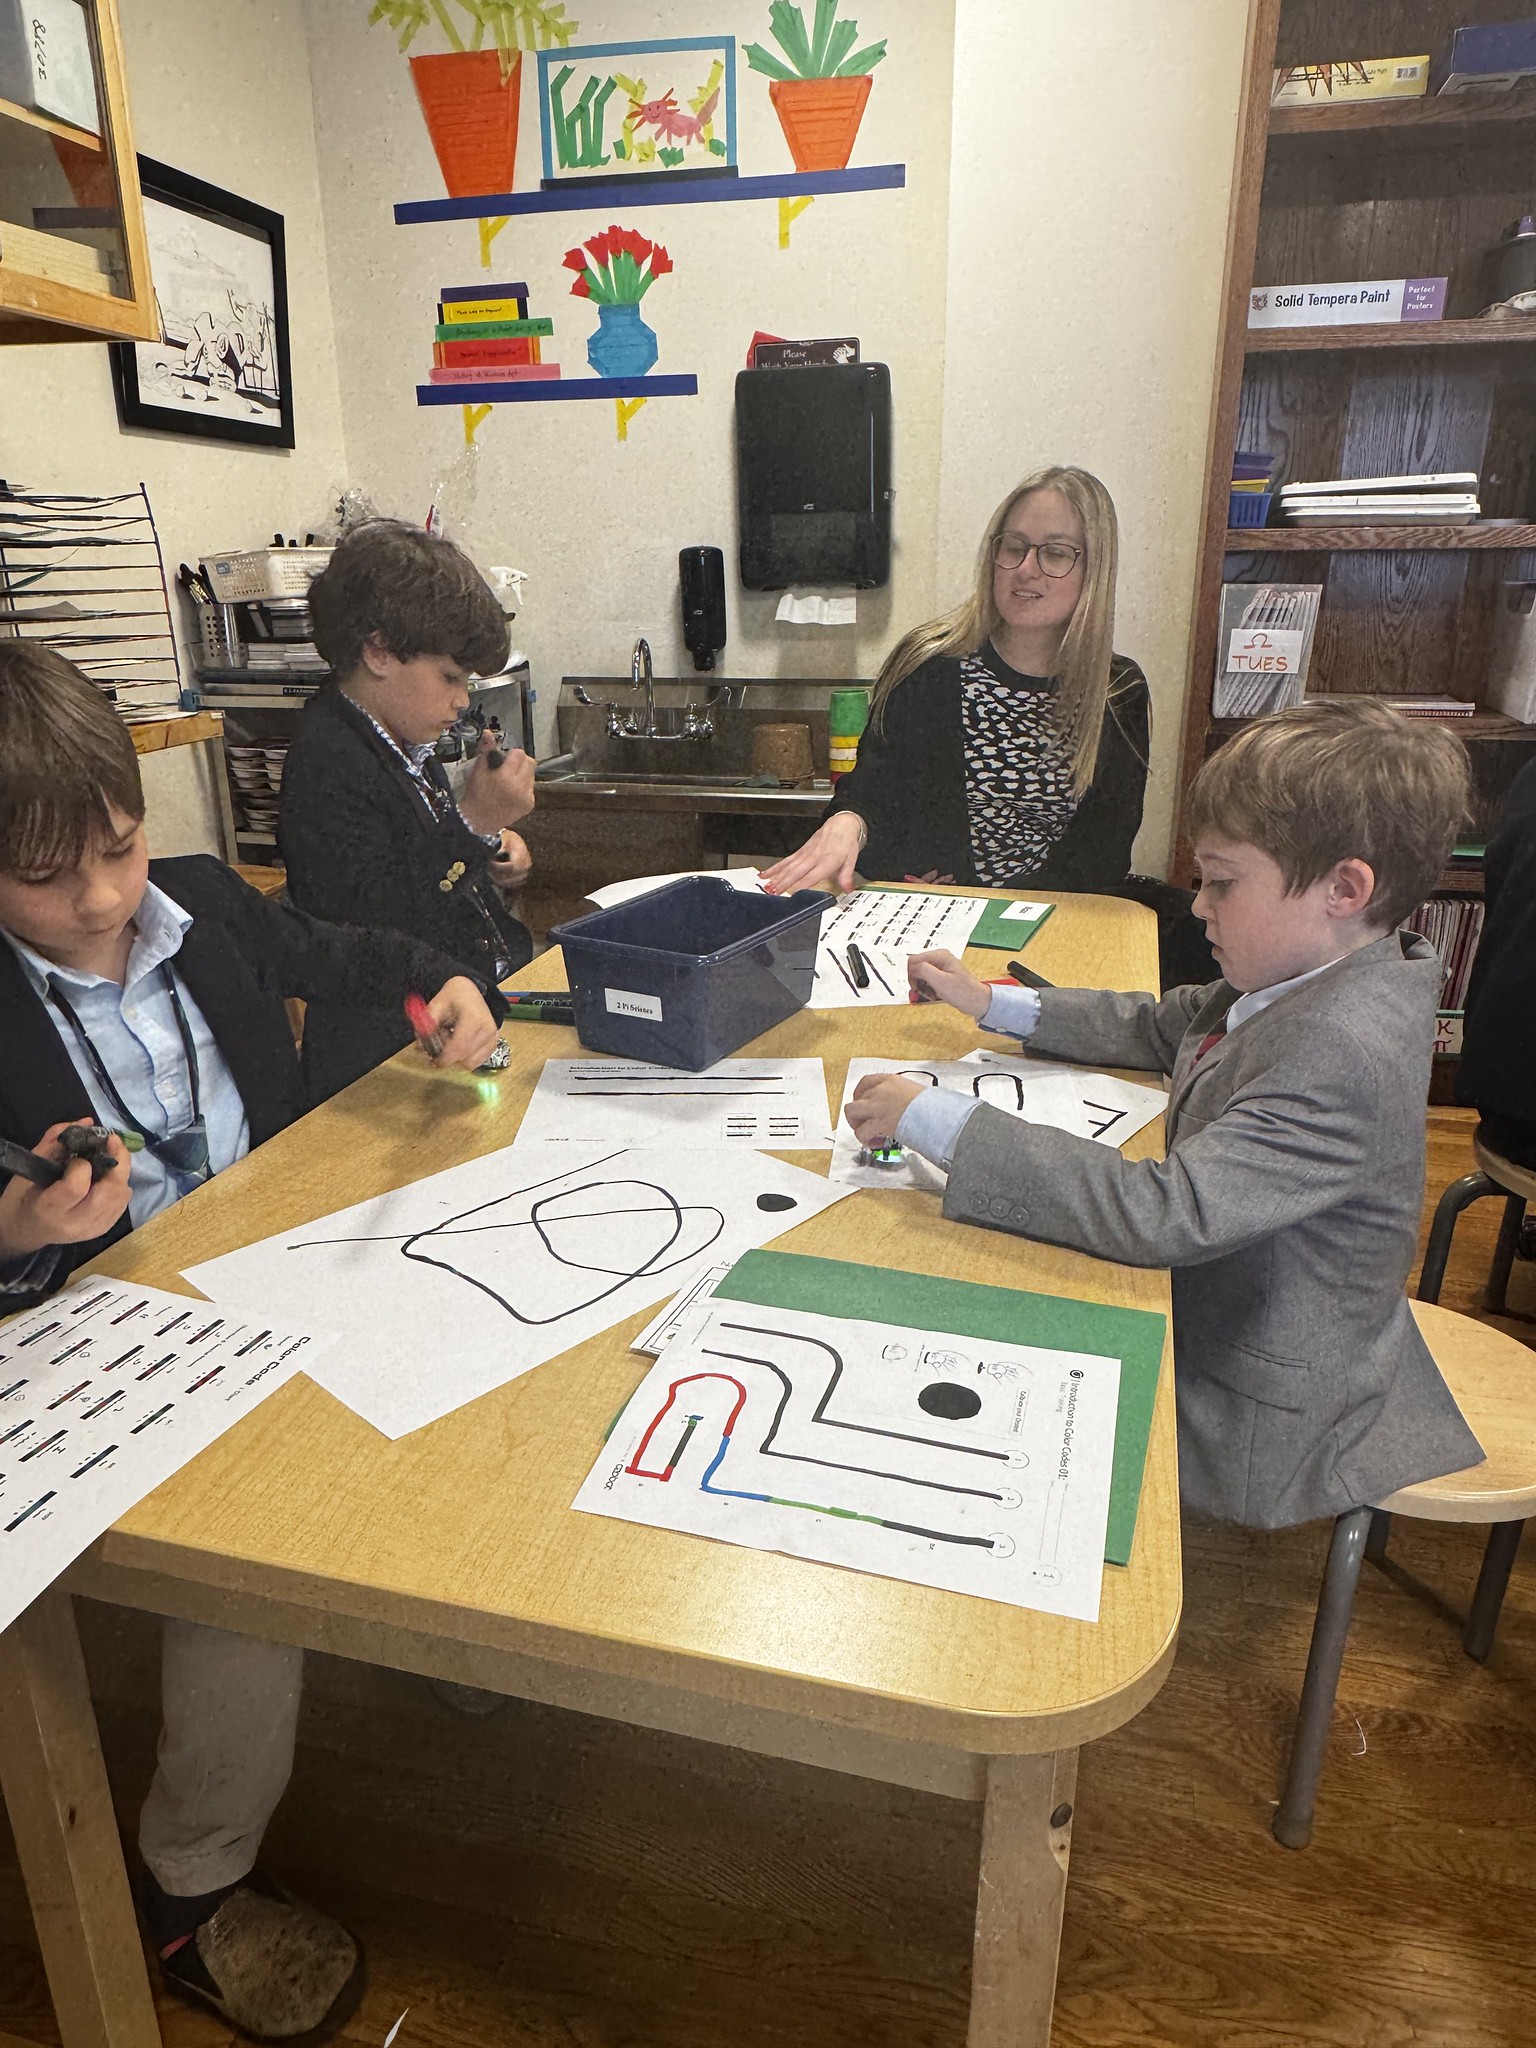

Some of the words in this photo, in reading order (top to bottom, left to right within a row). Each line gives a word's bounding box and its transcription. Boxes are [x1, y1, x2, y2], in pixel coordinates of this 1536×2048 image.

[1275, 293, 1304, 308] Solid
[1308, 292, 1357, 308] Tempera
[1360, 288, 1391, 304] Paint
[783, 349, 807, 358] Please
[1232, 655, 1288, 672] TUES
[630, 1004, 653, 1015] Science
[279, 1336, 312, 1361] Color
[245, 1361, 280, 1386] Code
[1064, 1428, 1074, 1446] Color
[1060, 1446, 1071, 1468] Codes
